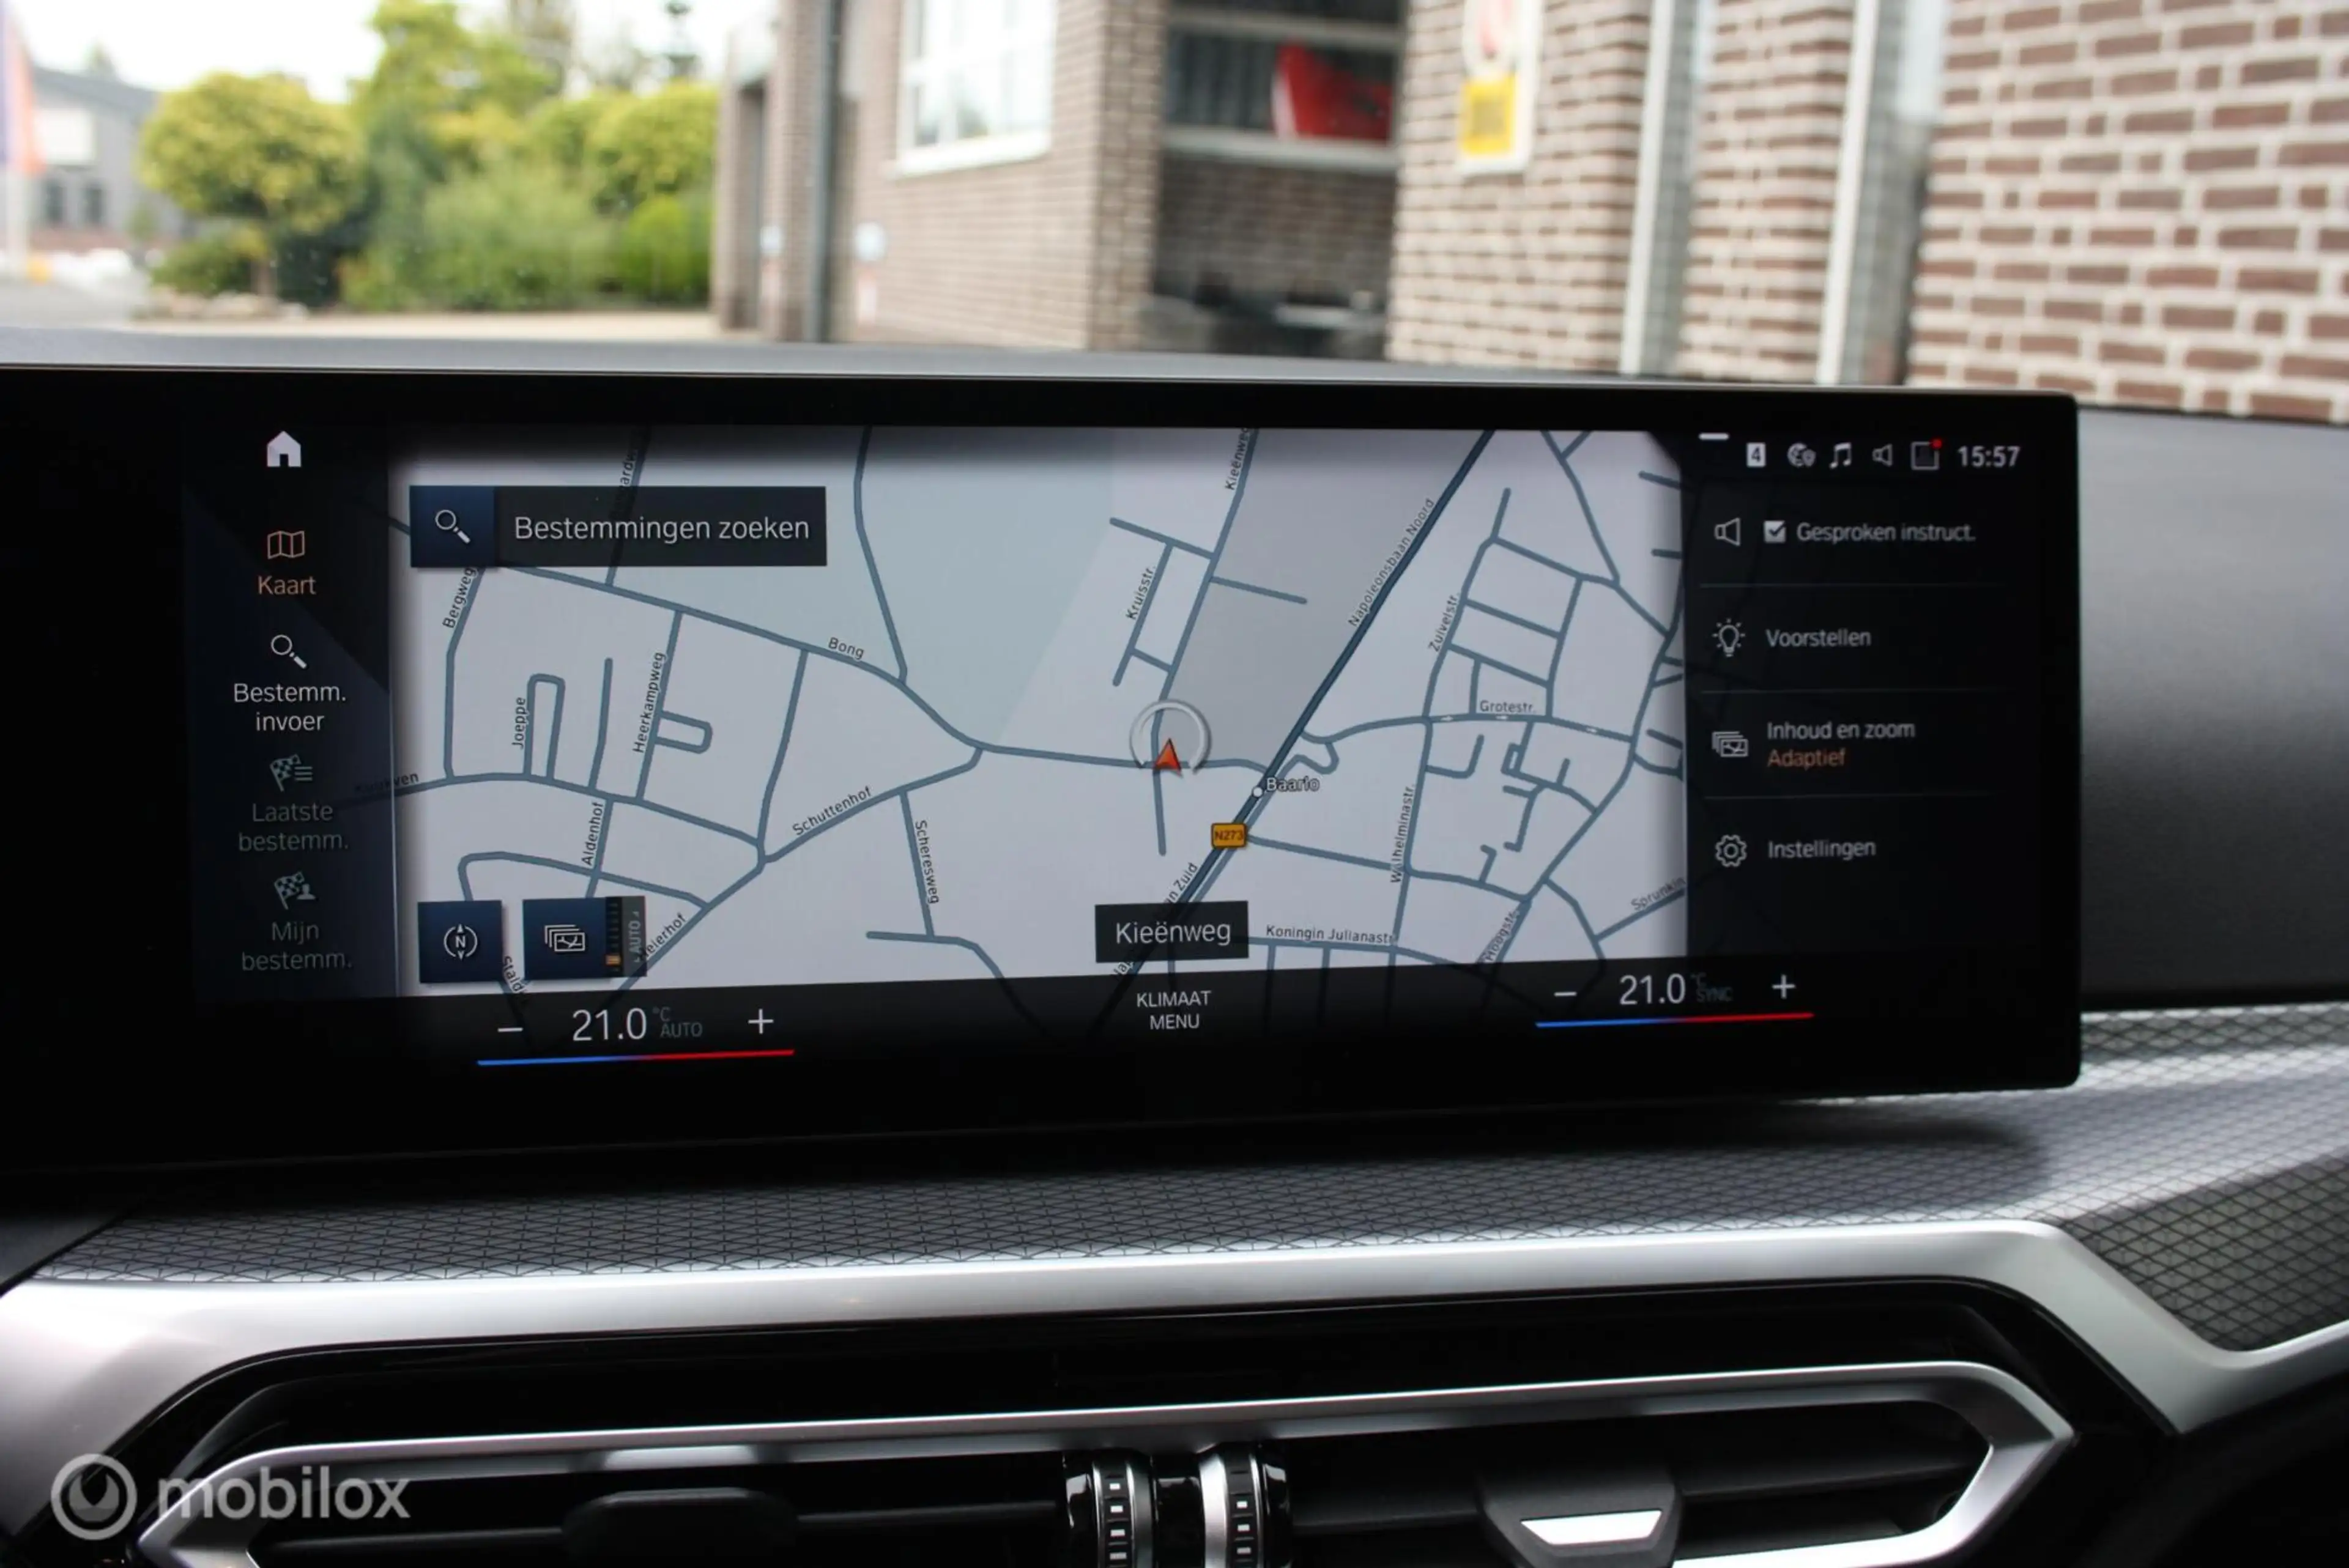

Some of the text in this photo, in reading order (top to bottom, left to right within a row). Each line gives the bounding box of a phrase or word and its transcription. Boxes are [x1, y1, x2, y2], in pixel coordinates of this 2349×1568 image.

[1958, 446, 2021, 467] 15:57
[515, 516, 809, 544] Bestemmingen zoeken
[1797, 522, 1976, 543] Gesproken instruct.
[1348, 498, 1434, 627] Napoleonsbaan Noord
[257, 575, 316, 595] Kaart
[1126, 564, 1156, 620] Kruisstr.
[442, 566, 477, 629] Bergweg
[828, 637, 864, 660] Bong
[1767, 629, 1871, 647] Voorstellen
[234, 683, 346, 703] Bestemm.
[633, 651, 666, 753] Heerkampweg
[256, 711, 325, 731] invoer
[512, 697, 527, 750] Joeppe
[1768, 722, 1915, 740] Inhoud en zoom
[1768, 749, 1846, 770] Adaptief
[252, 803, 333, 823] Laatste
[792, 785, 872, 836] Schuttenhof
[239, 832, 349, 852] bestemm.
[581, 802, 604, 866] Aldenhof
[1214, 829, 1244, 841] N273
[1768, 840, 1876, 861] Instellingen
[915, 819, 940, 905] Scheresweg
[1173, 862, 1198, 892] Zuid
[272, 921, 319, 945] Mijn
[628, 920, 641, 953] AUTO
[1116, 919, 1231, 946] Kieënweg
[1266, 925, 1397, 944] Koningin Julianastr
[242, 951, 352, 972] bestemm.
[1137, 990, 1211, 1008] KLIMAAT
[1620, 972, 1686, 1005] 21.0
[573, 1007, 647, 1041] 21.0
[660, 1022, 703, 1038] AUTO
[1150, 1014, 1200, 1030] MENU
